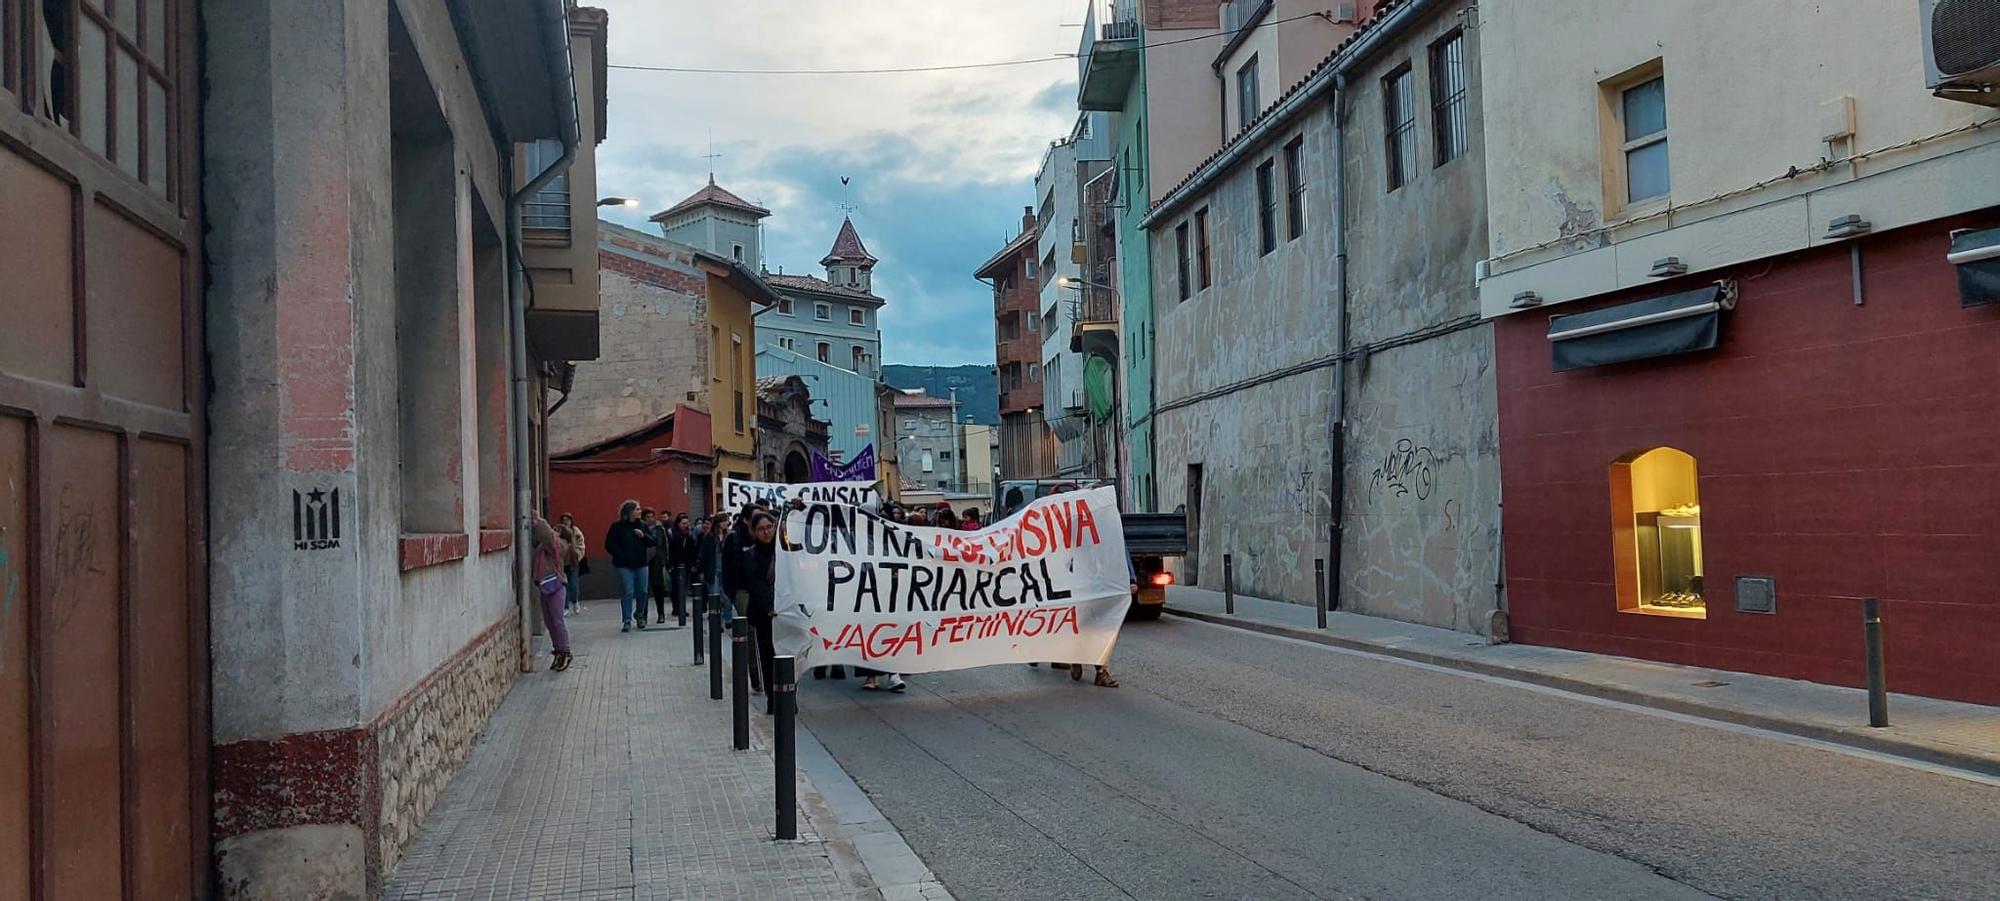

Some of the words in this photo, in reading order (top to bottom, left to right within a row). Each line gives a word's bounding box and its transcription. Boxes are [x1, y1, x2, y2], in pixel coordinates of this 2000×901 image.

[798, 486, 872, 504] CANSAT
[294, 542, 307, 550] HI
[310, 540, 340, 550] SOM
[779, 502, 924, 559] CONTRA
[827, 557, 1071, 613] PATRIARCAL
[932, 606, 1079, 647] FEMINISTA
